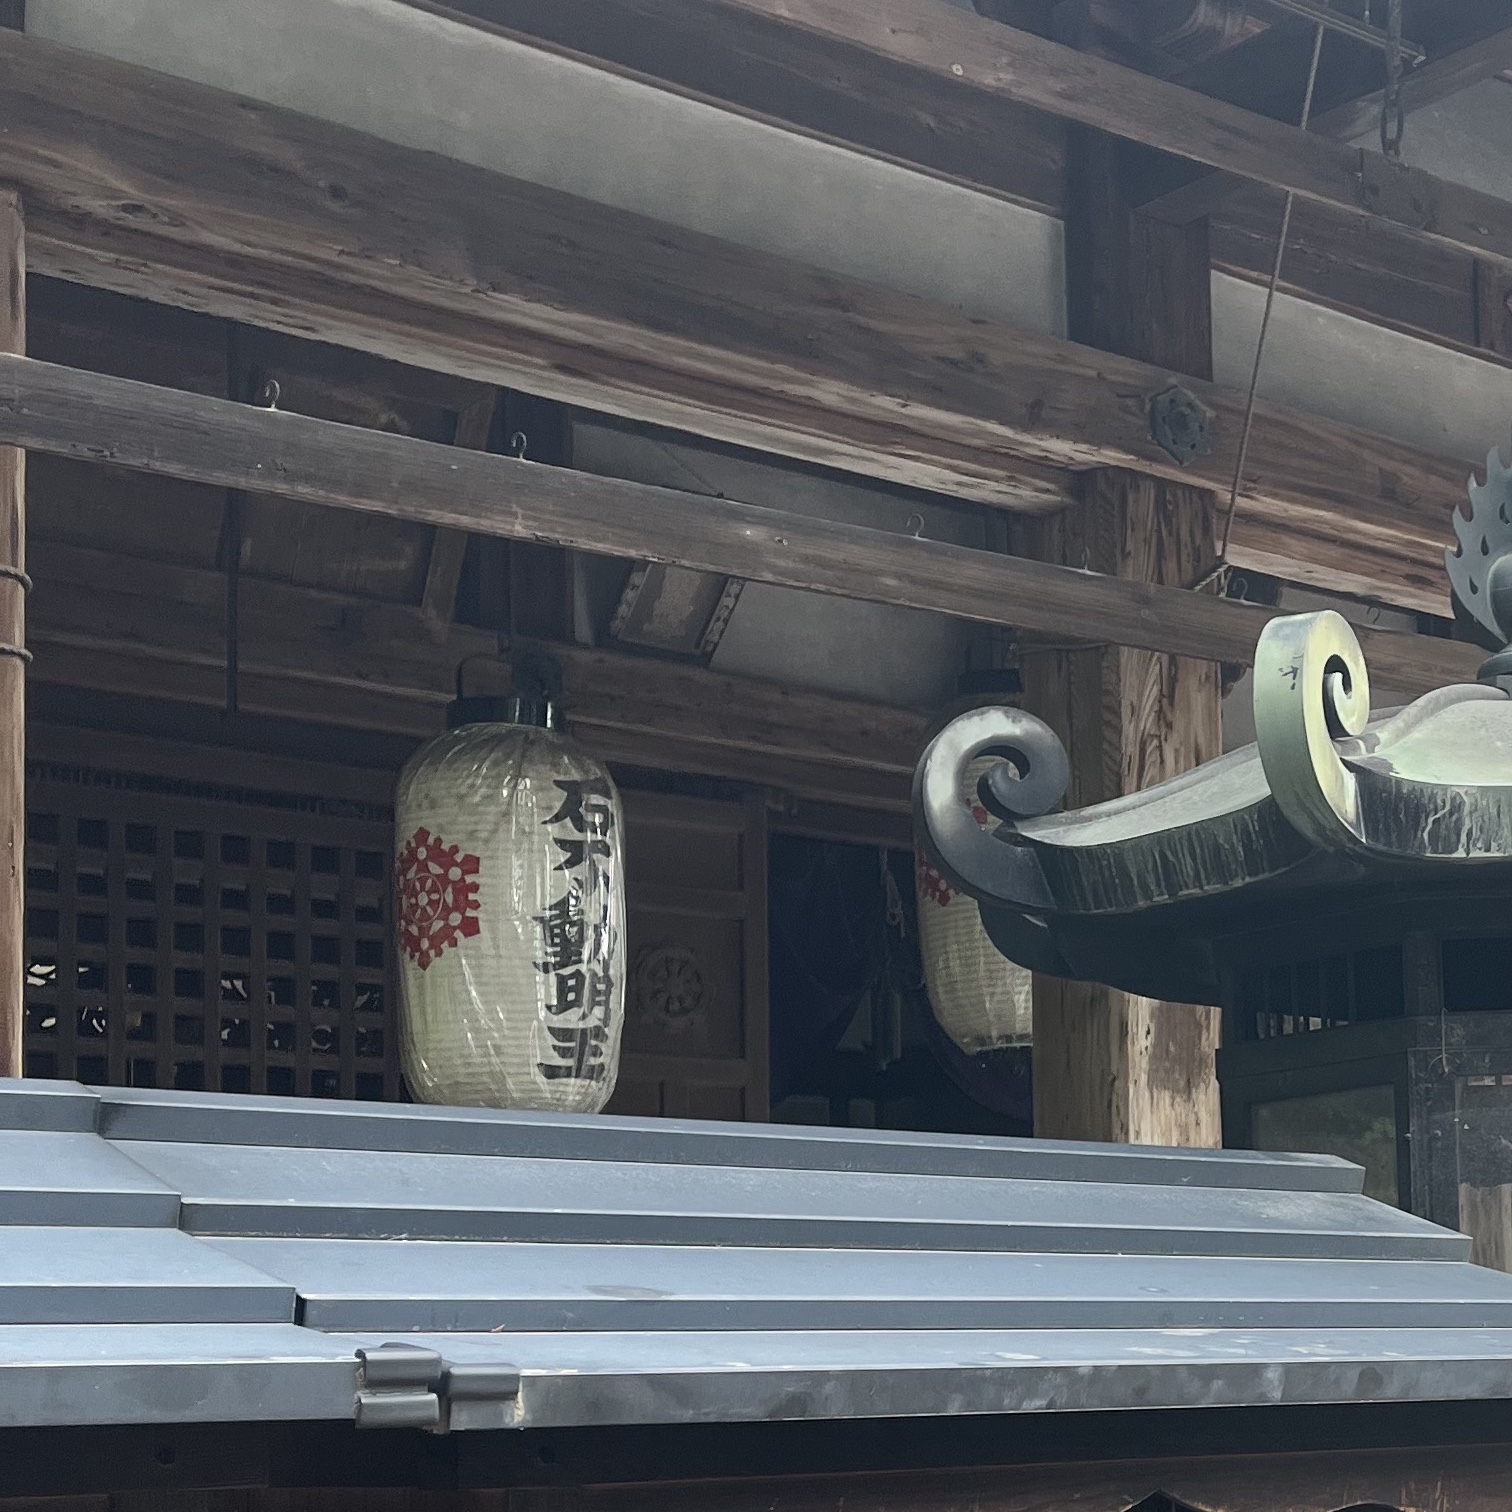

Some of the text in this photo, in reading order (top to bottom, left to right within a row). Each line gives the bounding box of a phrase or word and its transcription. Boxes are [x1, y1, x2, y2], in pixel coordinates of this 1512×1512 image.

[532, 778, 617, 1083] 石不動明王
